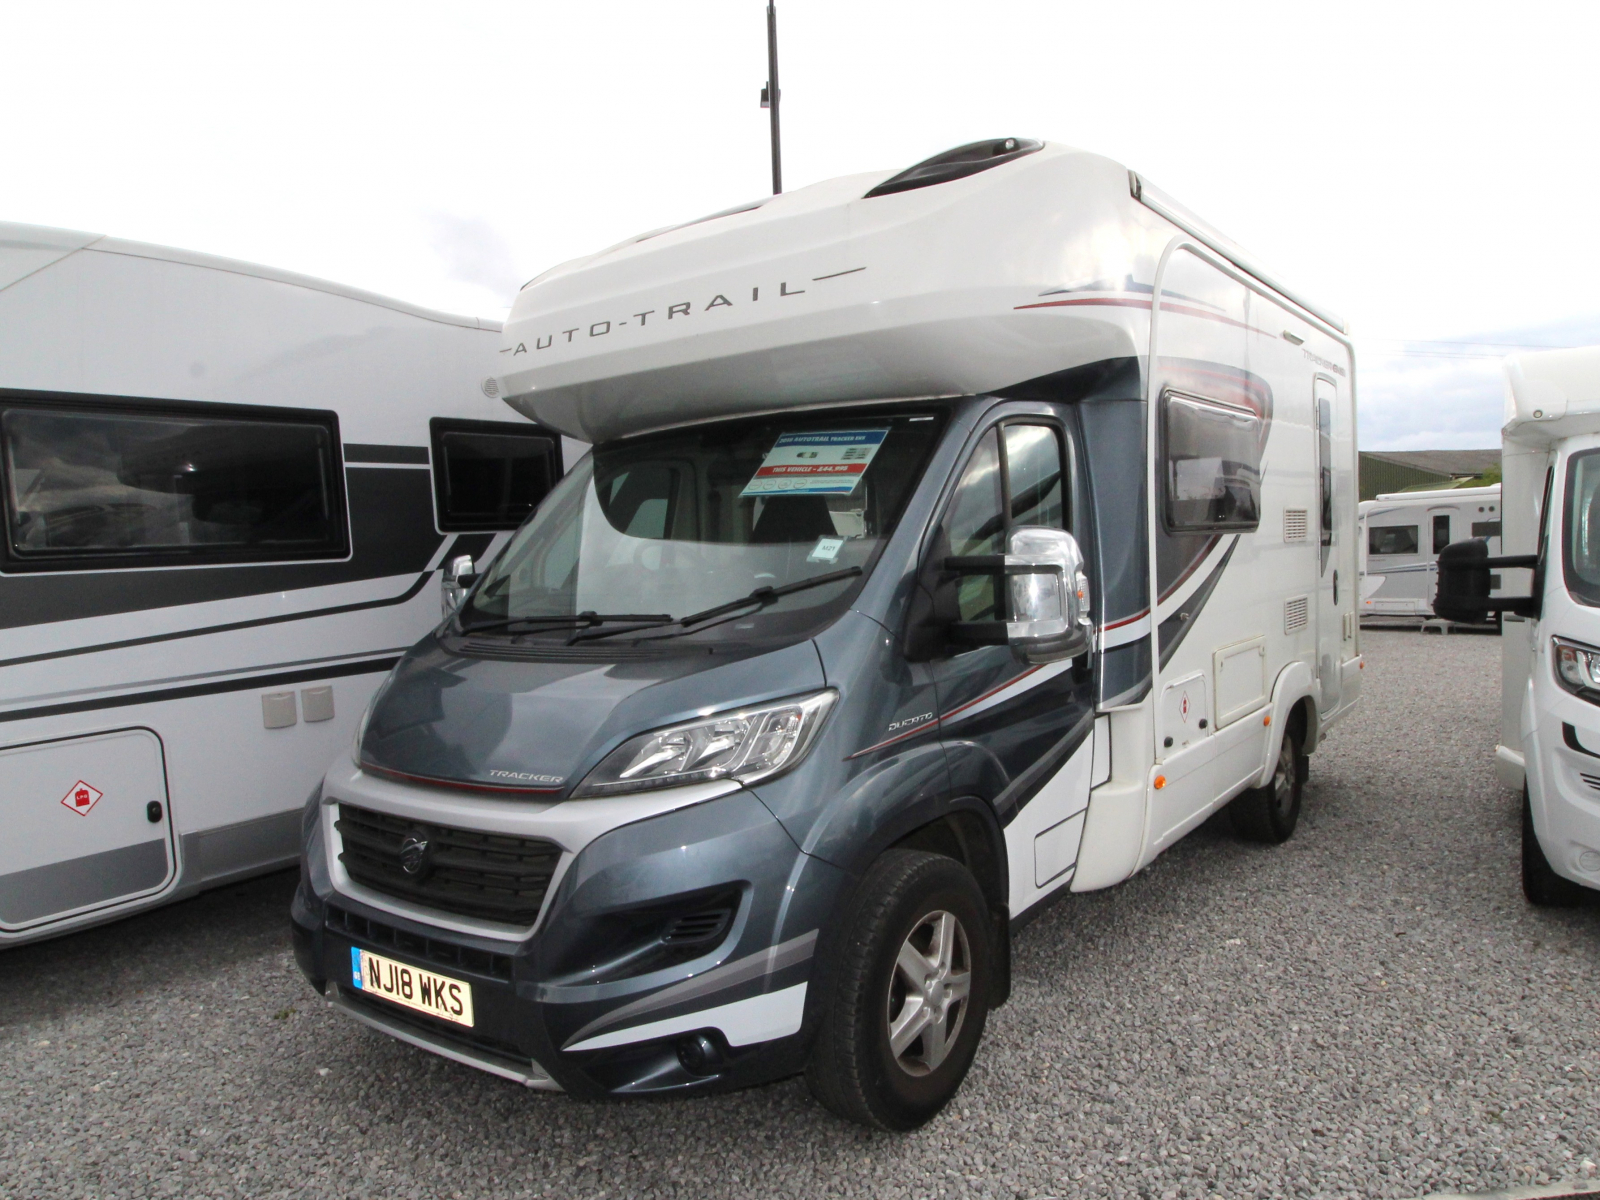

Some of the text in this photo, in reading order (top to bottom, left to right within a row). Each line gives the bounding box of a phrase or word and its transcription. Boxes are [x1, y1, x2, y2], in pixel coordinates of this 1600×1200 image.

[513, 282, 806, 356] AUTO-TRAIL
[888, 711, 933, 731] DUCATO
[489, 769, 564, 783] TRACKER
[368, 956, 464, 1016] NJ18 WKS
